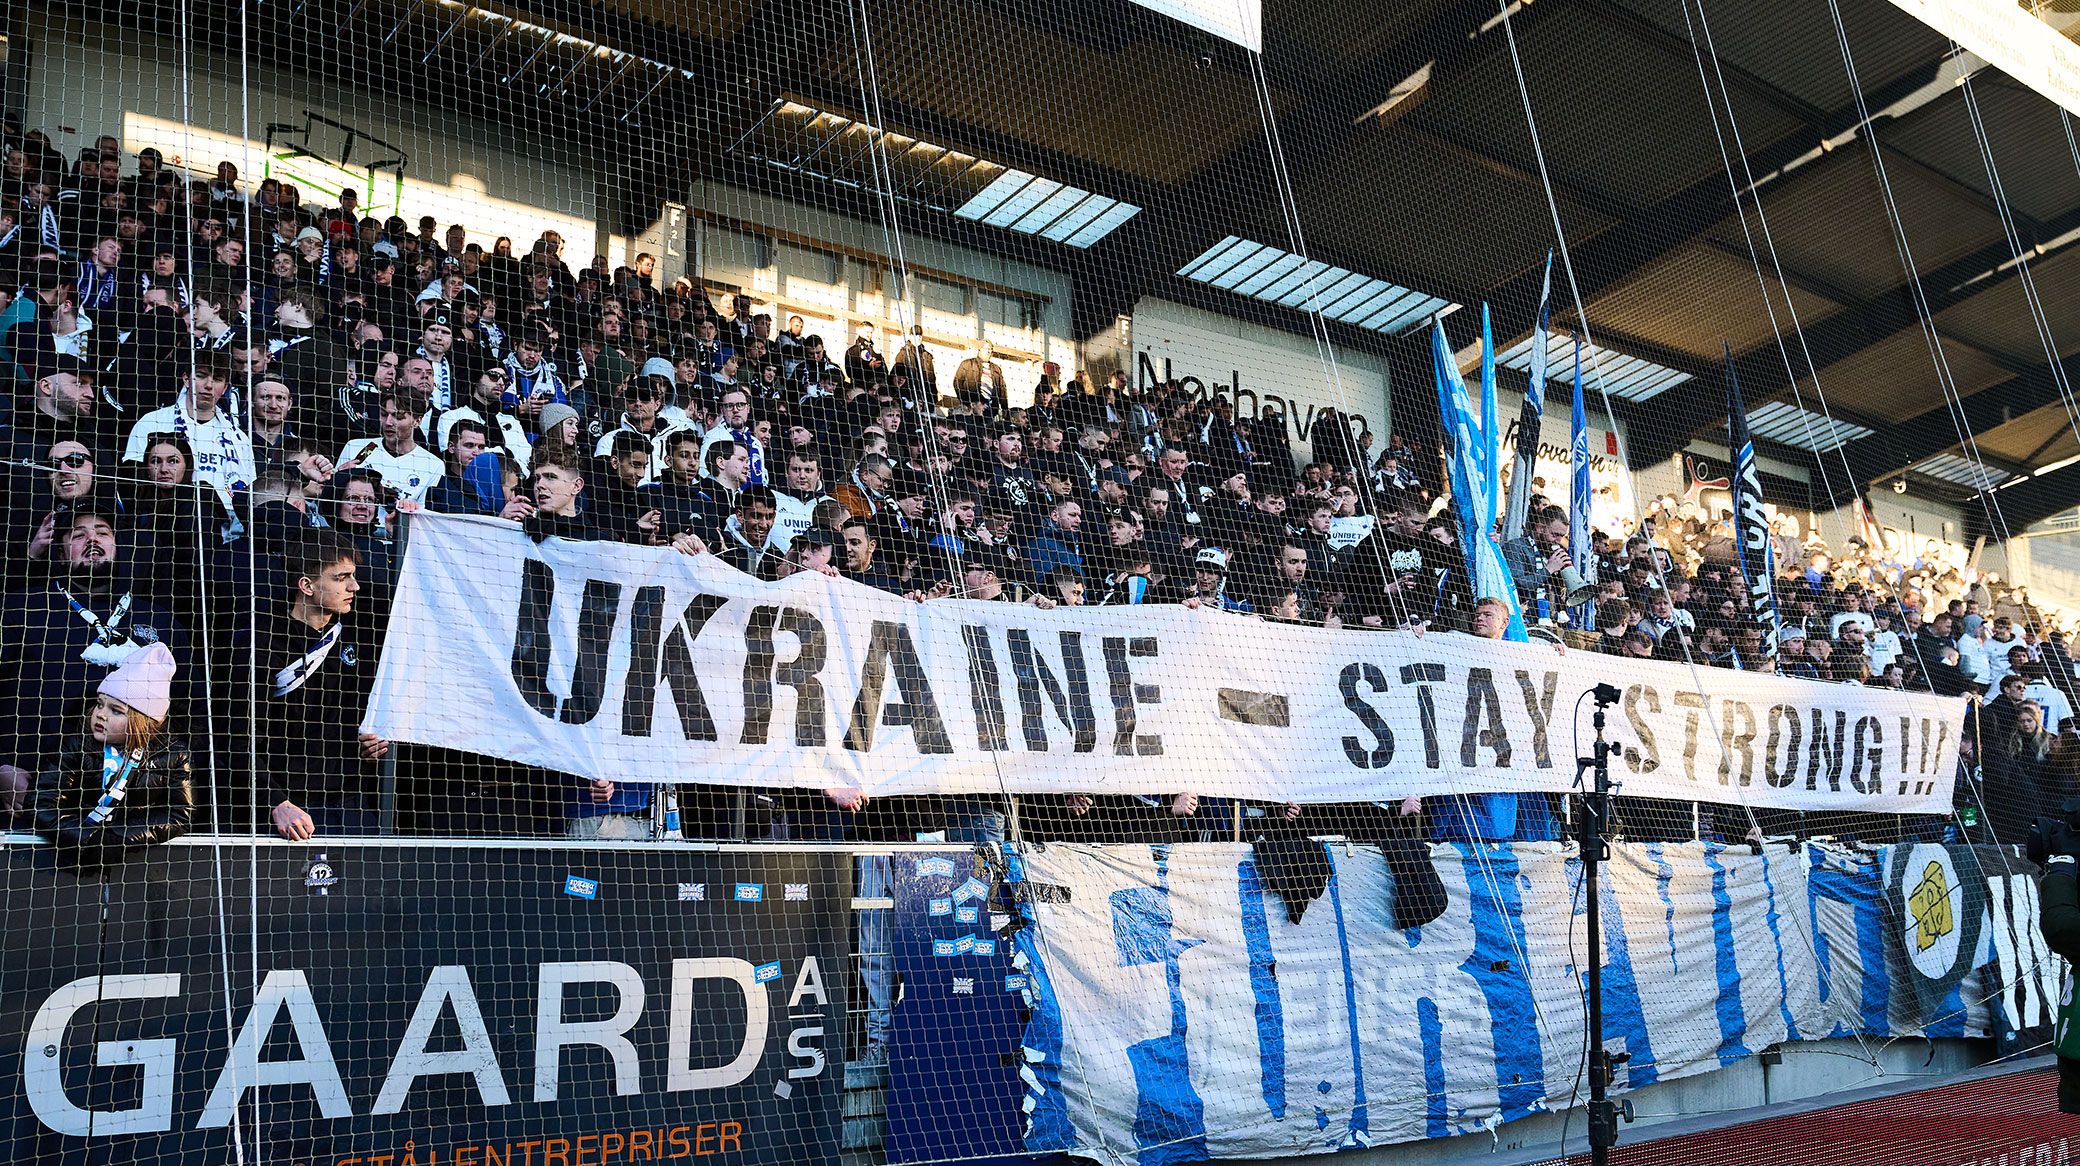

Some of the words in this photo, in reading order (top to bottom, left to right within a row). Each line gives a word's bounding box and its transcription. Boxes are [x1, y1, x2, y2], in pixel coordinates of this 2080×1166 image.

[1332, 532, 1361, 540] UNIBET
[511, 557, 1164, 757] UKRAINE
[1338, 662, 1558, 770] STAY
[314, 869, 328, 879] 12
[23, 957, 769, 1137] GAARD
